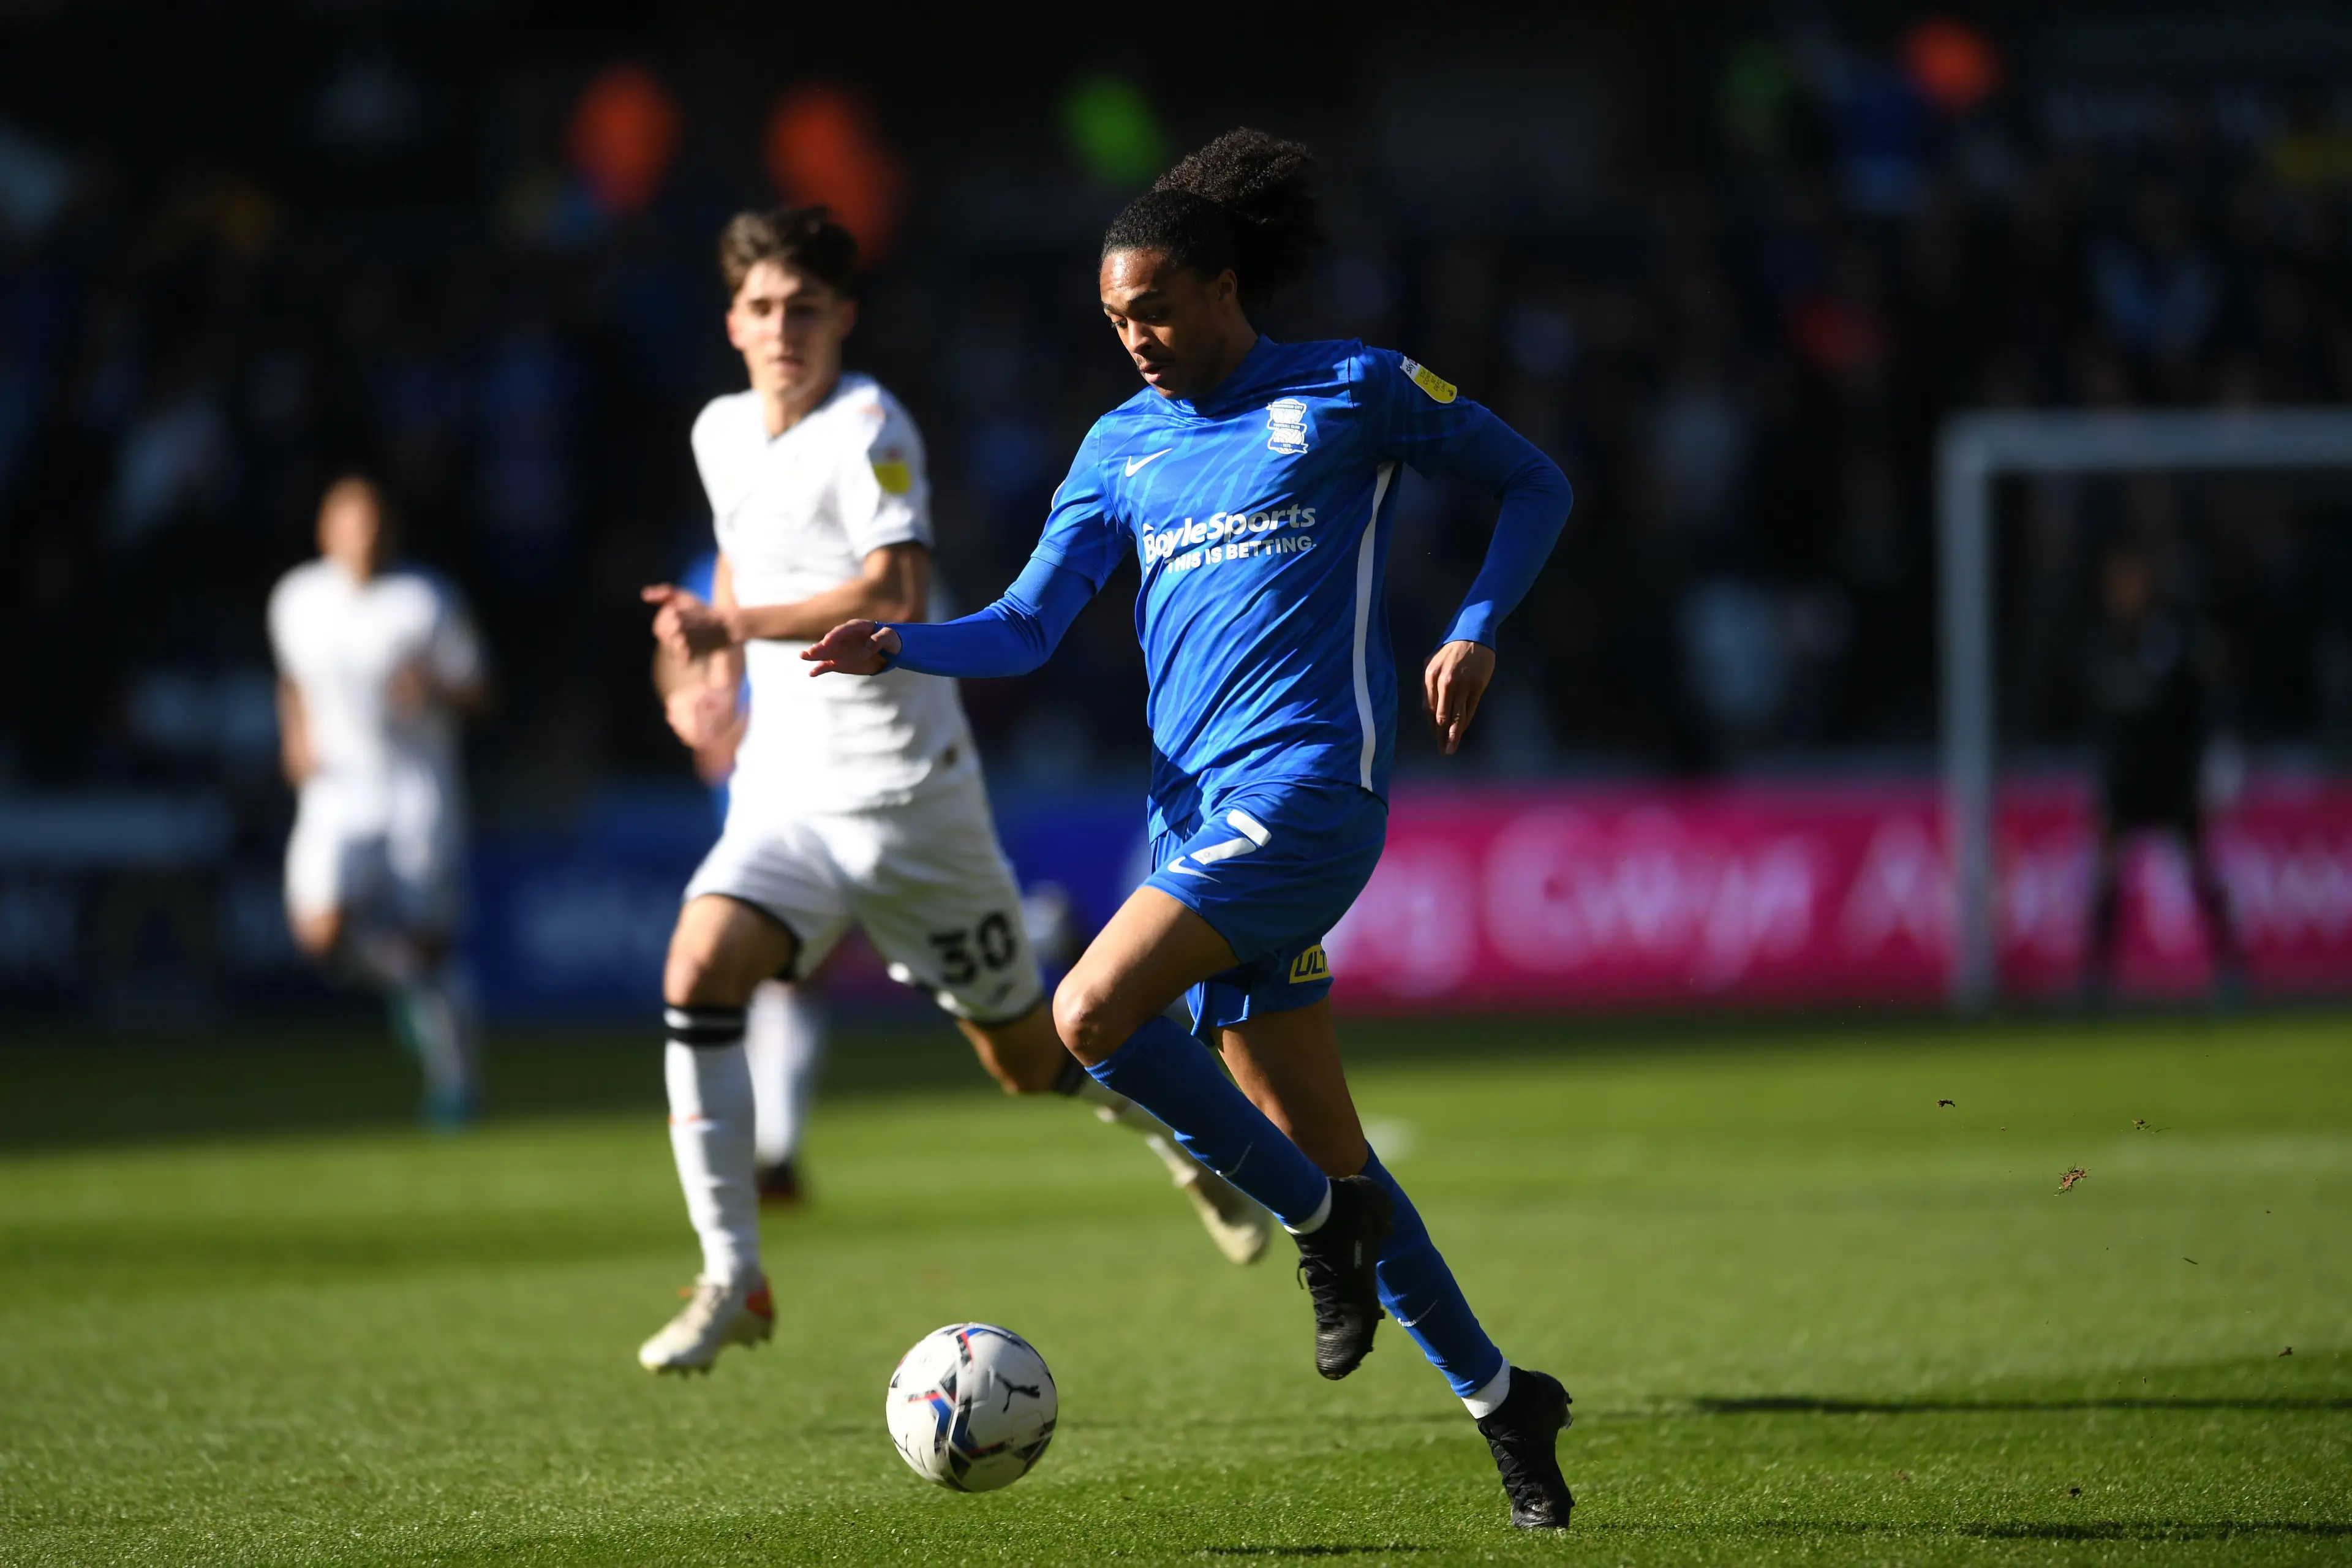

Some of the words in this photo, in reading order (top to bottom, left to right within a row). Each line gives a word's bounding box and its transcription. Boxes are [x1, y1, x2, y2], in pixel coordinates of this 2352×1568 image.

[1406, 362, 1416, 374] sky
[1142, 503, 1316, 564] BoyleSports
[1164, 551, 1201, 574] THIS
[1205, 546, 1222, 565] IS
[927, 910, 1016, 985] 30
